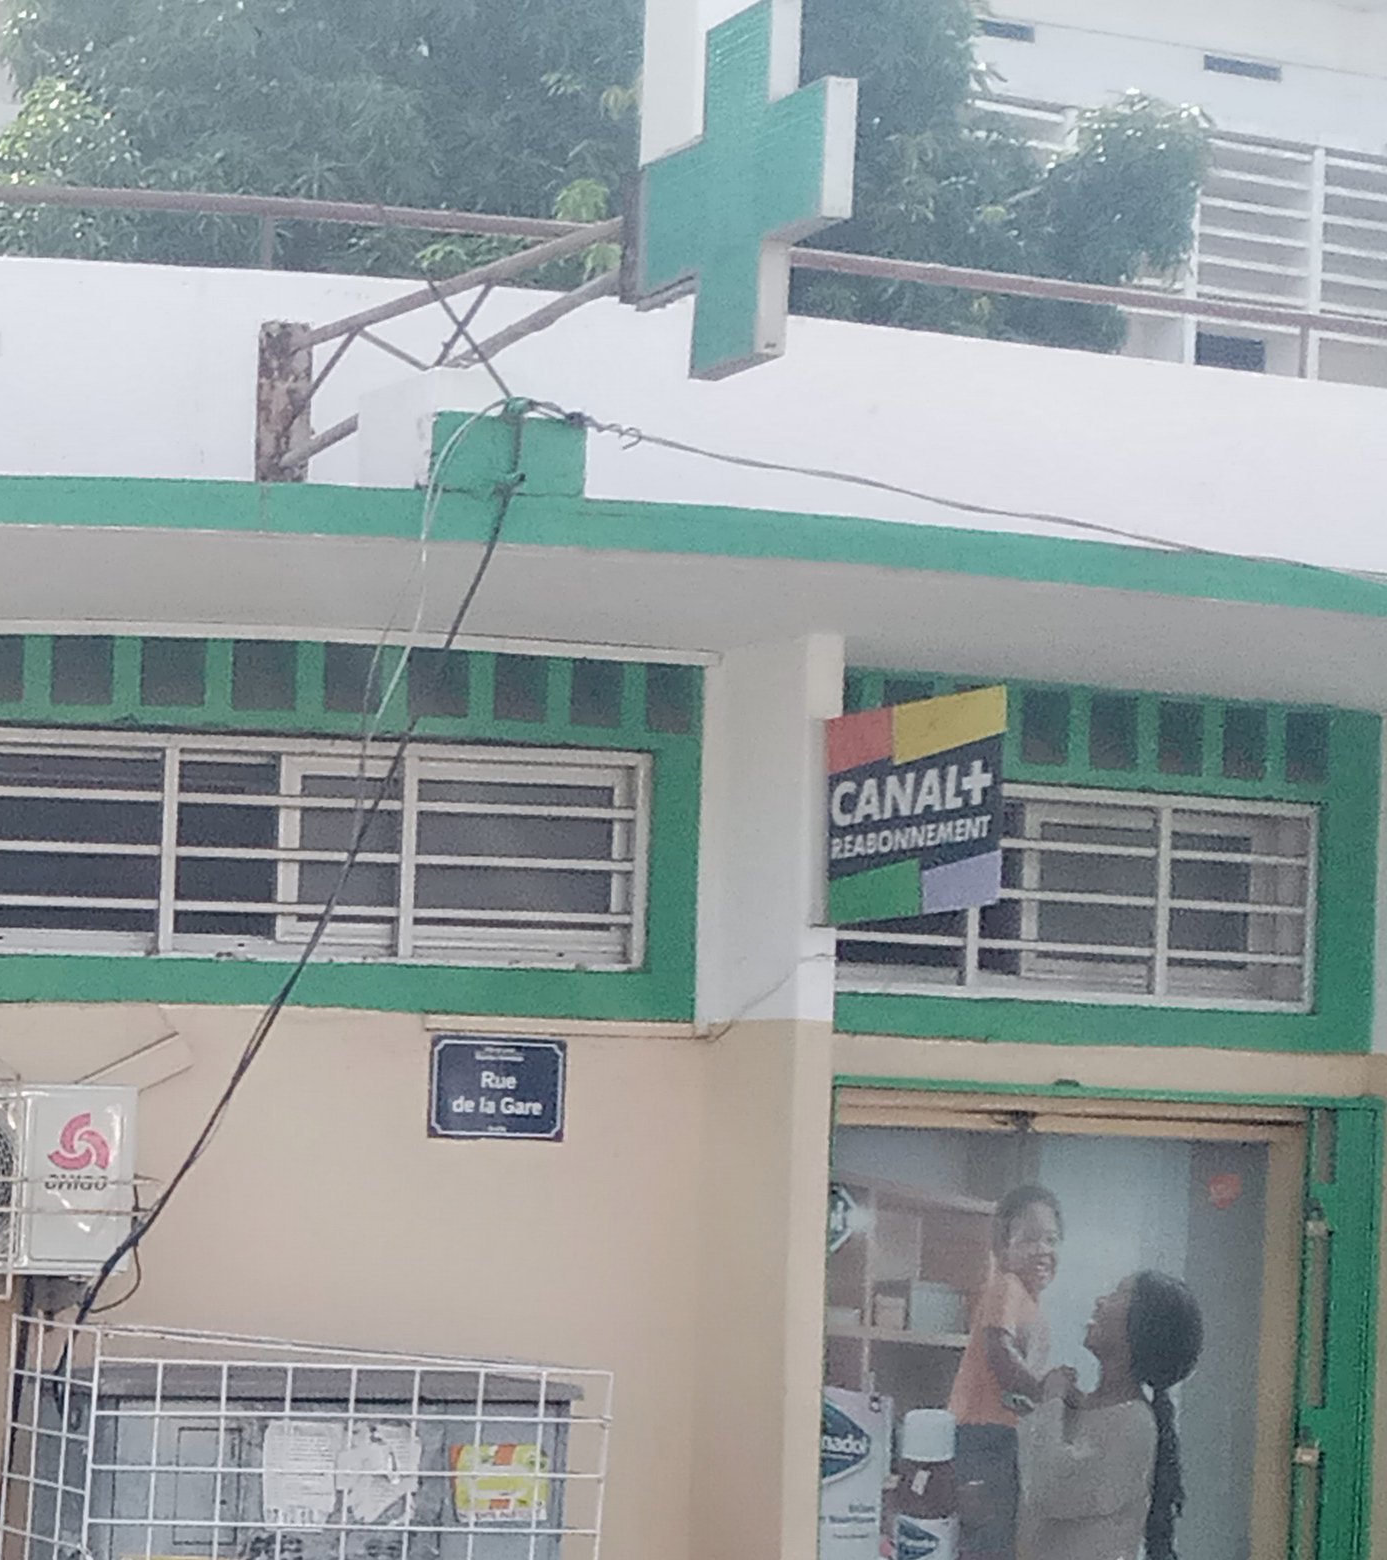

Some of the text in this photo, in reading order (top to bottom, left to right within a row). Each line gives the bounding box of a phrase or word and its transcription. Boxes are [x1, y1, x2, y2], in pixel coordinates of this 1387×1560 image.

[831, 759, 993, 827] CANAL+
[830, 814, 992, 860] REABONNEMENT
[480, 1070, 517, 1090] Rue
[452, 1095, 543, 1116] de la Gare
